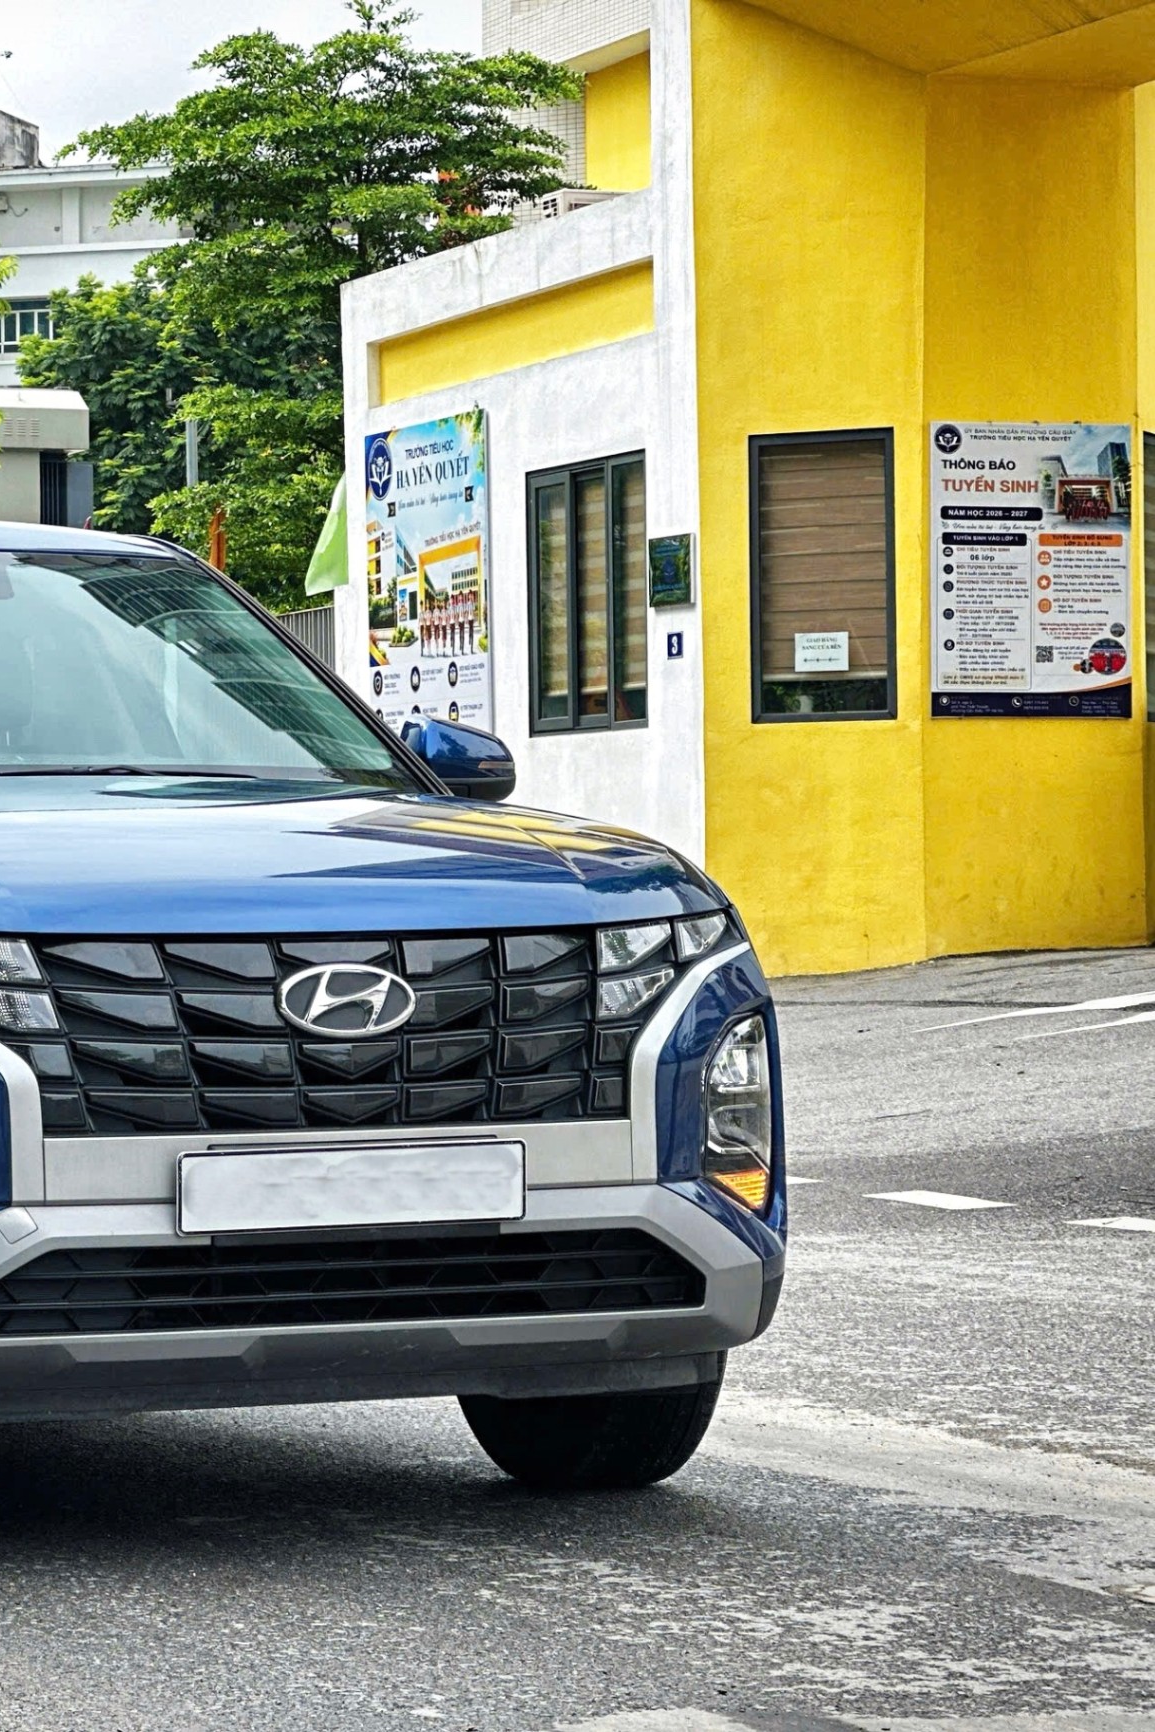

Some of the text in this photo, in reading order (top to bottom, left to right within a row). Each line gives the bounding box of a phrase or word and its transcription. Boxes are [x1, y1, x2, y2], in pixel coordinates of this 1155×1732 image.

[405, 444, 428, 459] TRƯỜNG
[429, 440, 441, 455] TIỂU
[442, 439, 453, 454] HỌC
[397, 450, 469, 490] HẠ YÊN QUYẾT
[942, 458, 1016, 470] THÔNG BÁO
[942, 475, 1039, 493] TUYỂN SINH
[982, 554, 995, 562] lớp
[672, 635, 678, 654] 3
